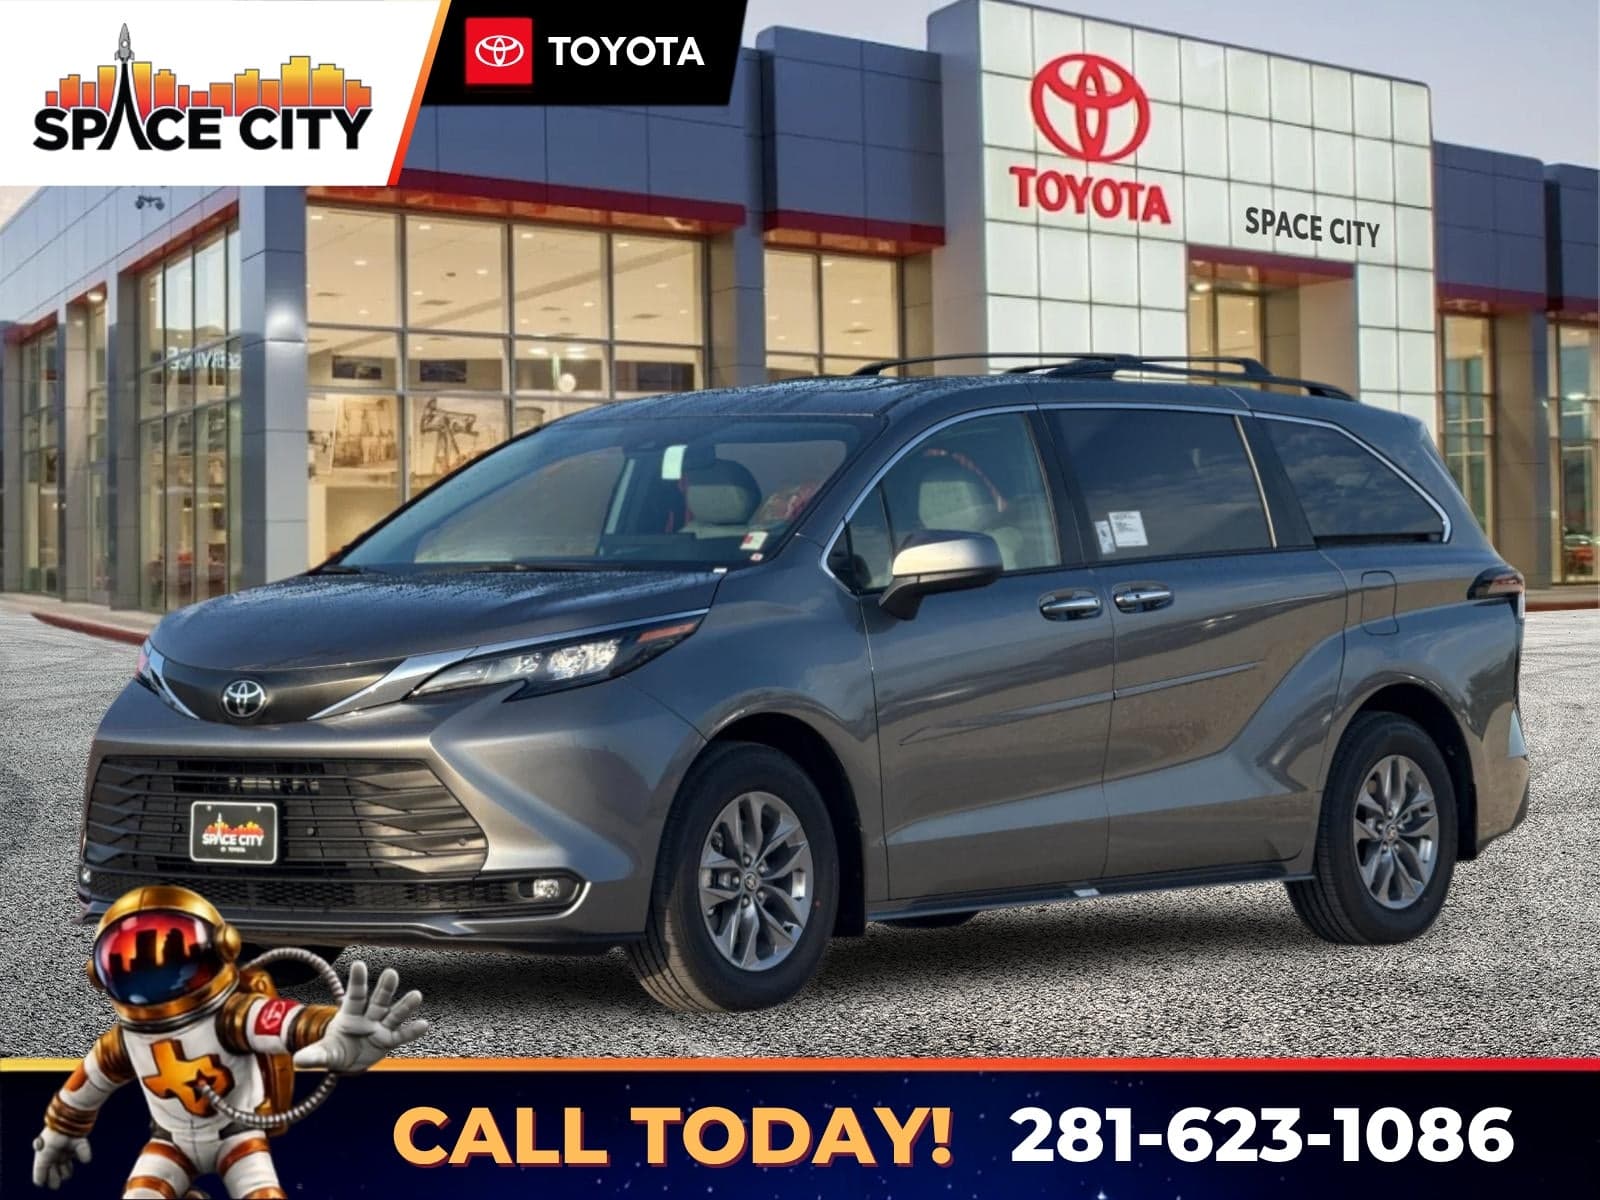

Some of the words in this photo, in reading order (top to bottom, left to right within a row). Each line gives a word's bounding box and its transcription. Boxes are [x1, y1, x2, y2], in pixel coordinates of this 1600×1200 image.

[1009, 166, 1171, 224] TOYOTA
[1245, 206, 1323, 241] SPACE
[1329, 217, 1381, 248] CITY
[202, 832, 237, 845] SPACE
[238, 834, 264, 846] CITY
